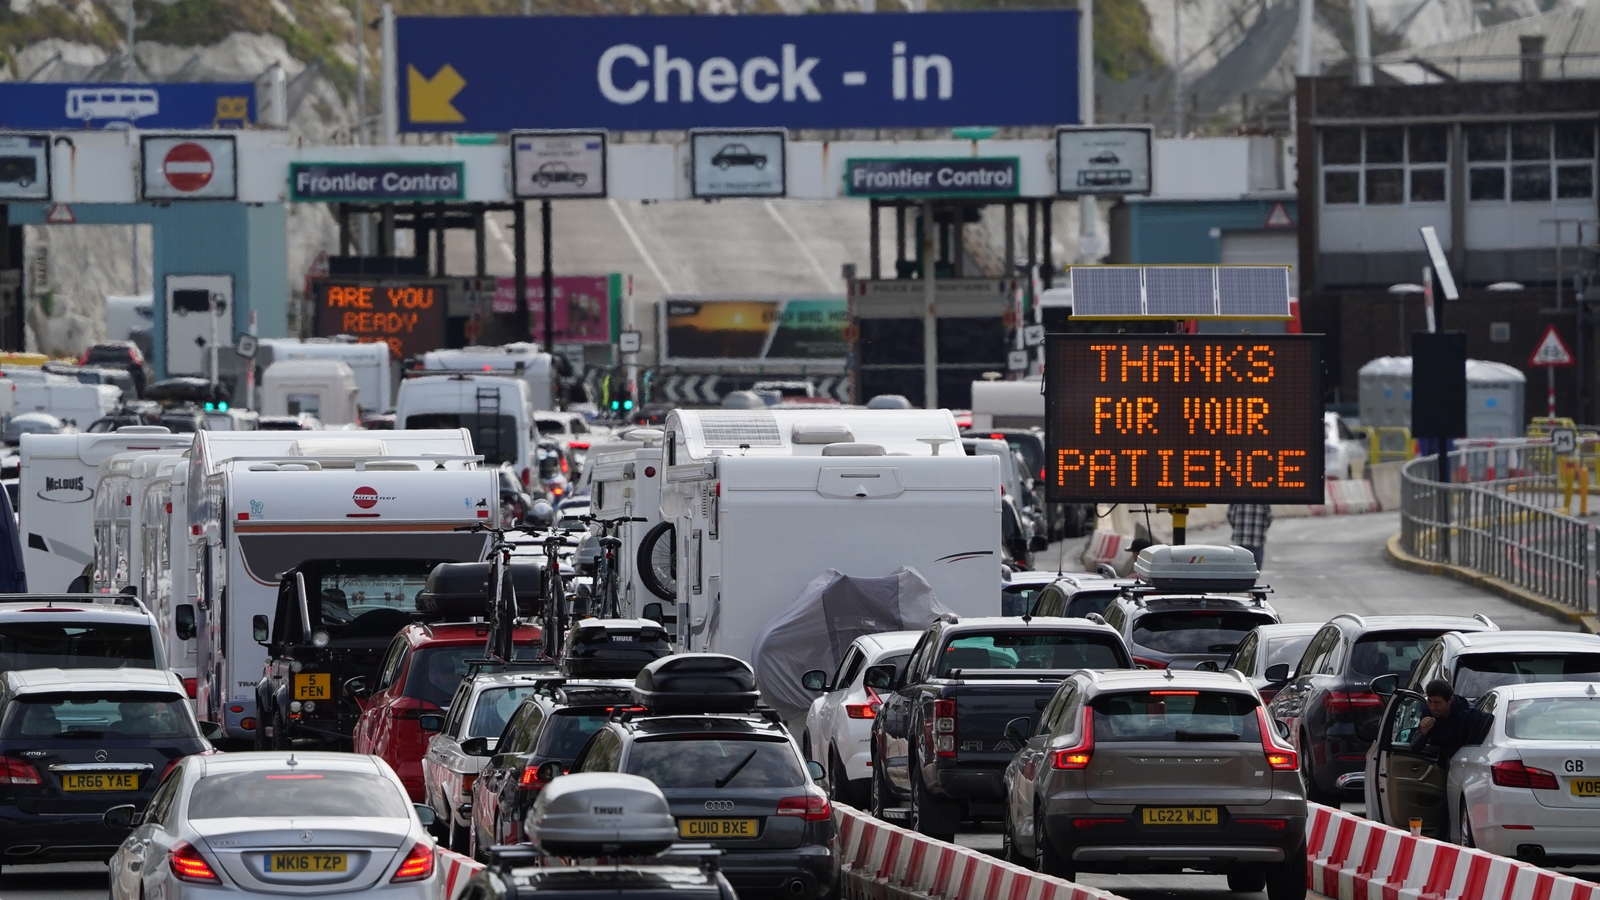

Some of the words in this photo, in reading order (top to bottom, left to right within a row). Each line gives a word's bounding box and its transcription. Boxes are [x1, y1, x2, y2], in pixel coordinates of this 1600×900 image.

[597, 43, 822, 105] Check
[842, 71, 867, 86] -
[892, 41, 953, 101] in
[296, 171, 378, 192] Frontier
[382, 171, 458, 192] Control
[852, 167, 933, 188] Frontier
[937, 166, 1013, 187] Control
[327, 286, 374, 309] ARE
[387, 287, 434, 309] YOU
[343, 311, 418, 333] READY
[1090, 345, 1274, 382] THANKS
[1094, 397, 1159, 434] FOR
[1184, 397, 1269, 434] YOUR
[1058, 449, 1305, 487] PATIENCE
[372, 580, 397, 588] family
[308, 674, 317, 686] 5
[301, 686, 325, 697] FEN
[1564, 759, 1584, 773] GB
[69, 775, 104, 788] LR66
[105, 774, 132, 788] YAE
[593, 806, 624, 815] THULE
[1149, 809, 1183, 822] LG22
[1186, 809, 1212, 822] WJC
[689, 821, 719, 834] CU10
[722, 821, 749, 834] BXE
[276, 856, 309, 870] MK16
[313, 856, 342, 870] TZP
